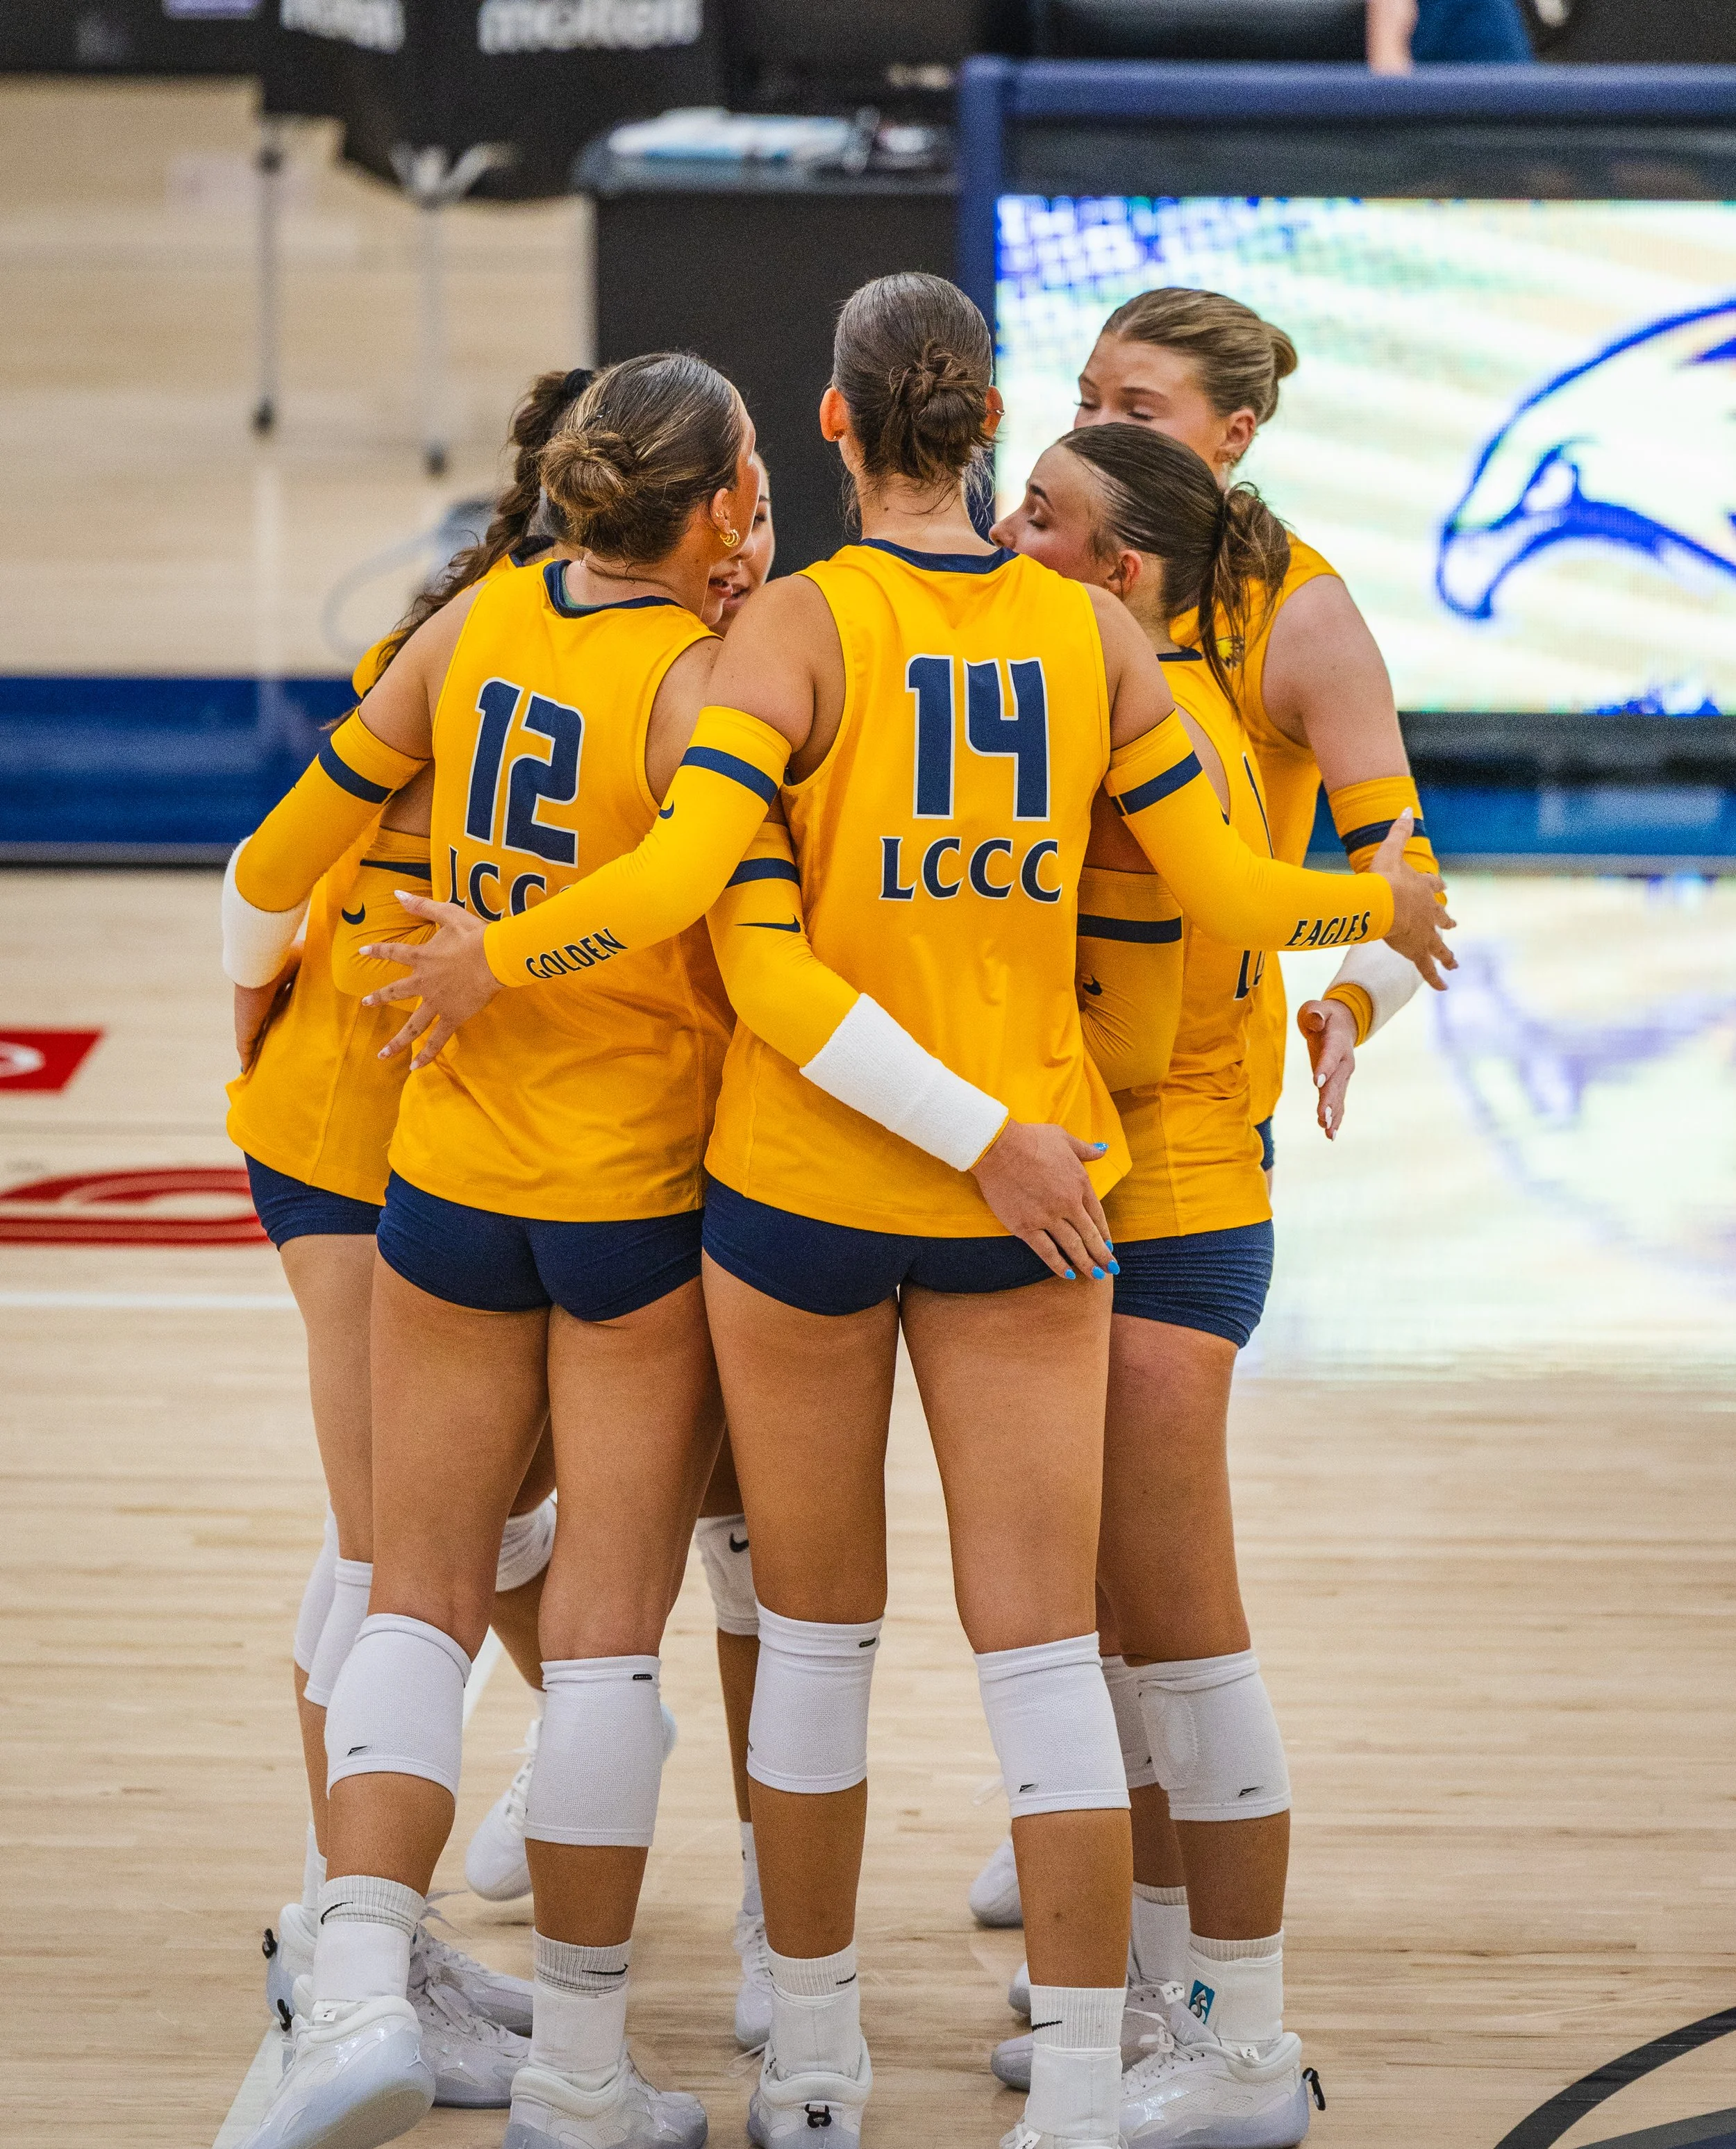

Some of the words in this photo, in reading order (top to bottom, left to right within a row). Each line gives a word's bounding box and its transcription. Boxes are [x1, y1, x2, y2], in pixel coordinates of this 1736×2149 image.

[465, 677, 585, 869] 12
[905, 653, 1051, 821] 14
[448, 844, 574, 923] LCC
[878, 835, 1062, 904] LCCC
[525, 927, 628, 980] GOLDEN
[1284, 910, 1371, 946] EAGLES
